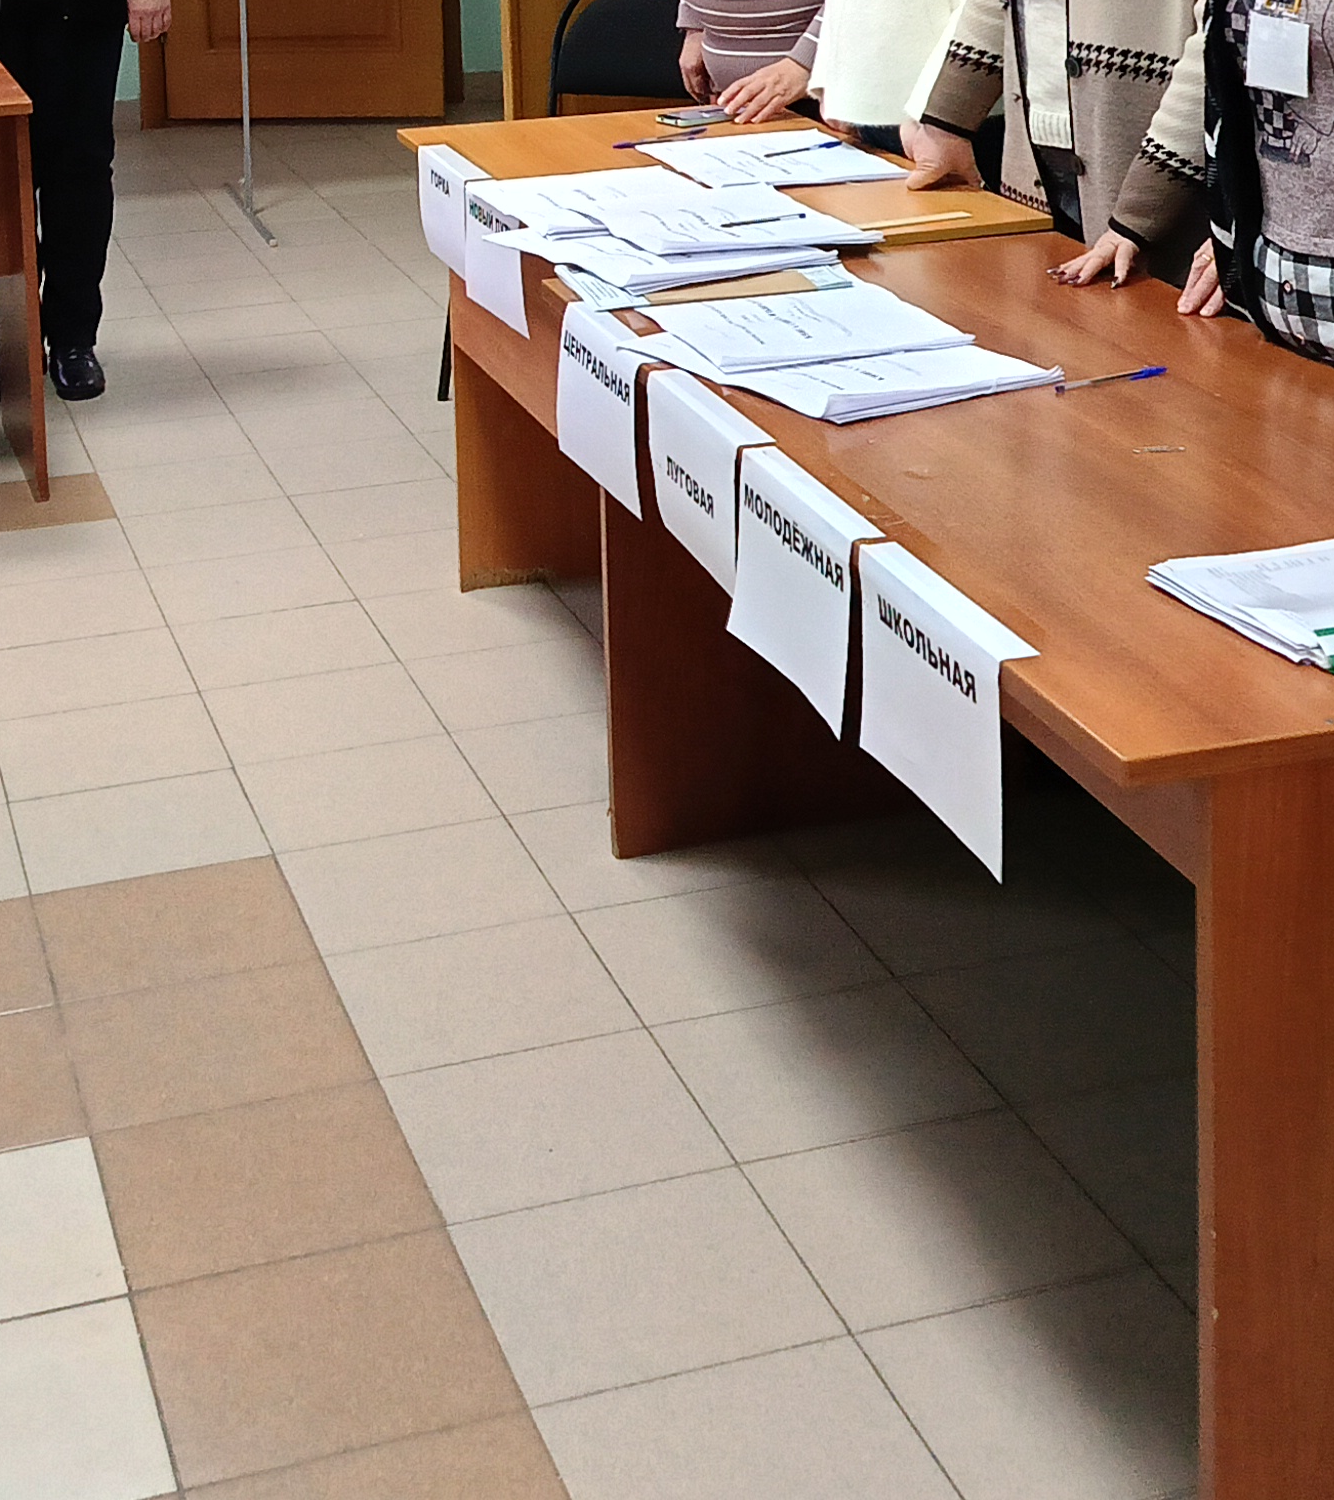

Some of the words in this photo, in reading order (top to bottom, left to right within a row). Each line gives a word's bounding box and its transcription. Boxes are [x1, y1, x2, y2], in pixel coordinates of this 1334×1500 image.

[430, 169, 451, 196] ГОРКА
[469, 199, 494, 231] НОВЫЙ
[563, 329, 632, 407] ЦЕНТРАЛЬНАЯ
[665, 455, 715, 521] ЛУГОВАЯ
[742, 483, 845, 594] МОЛОДЁЖНАЯ
[877, 594, 977, 704] ШКОЛЬНАЯ
